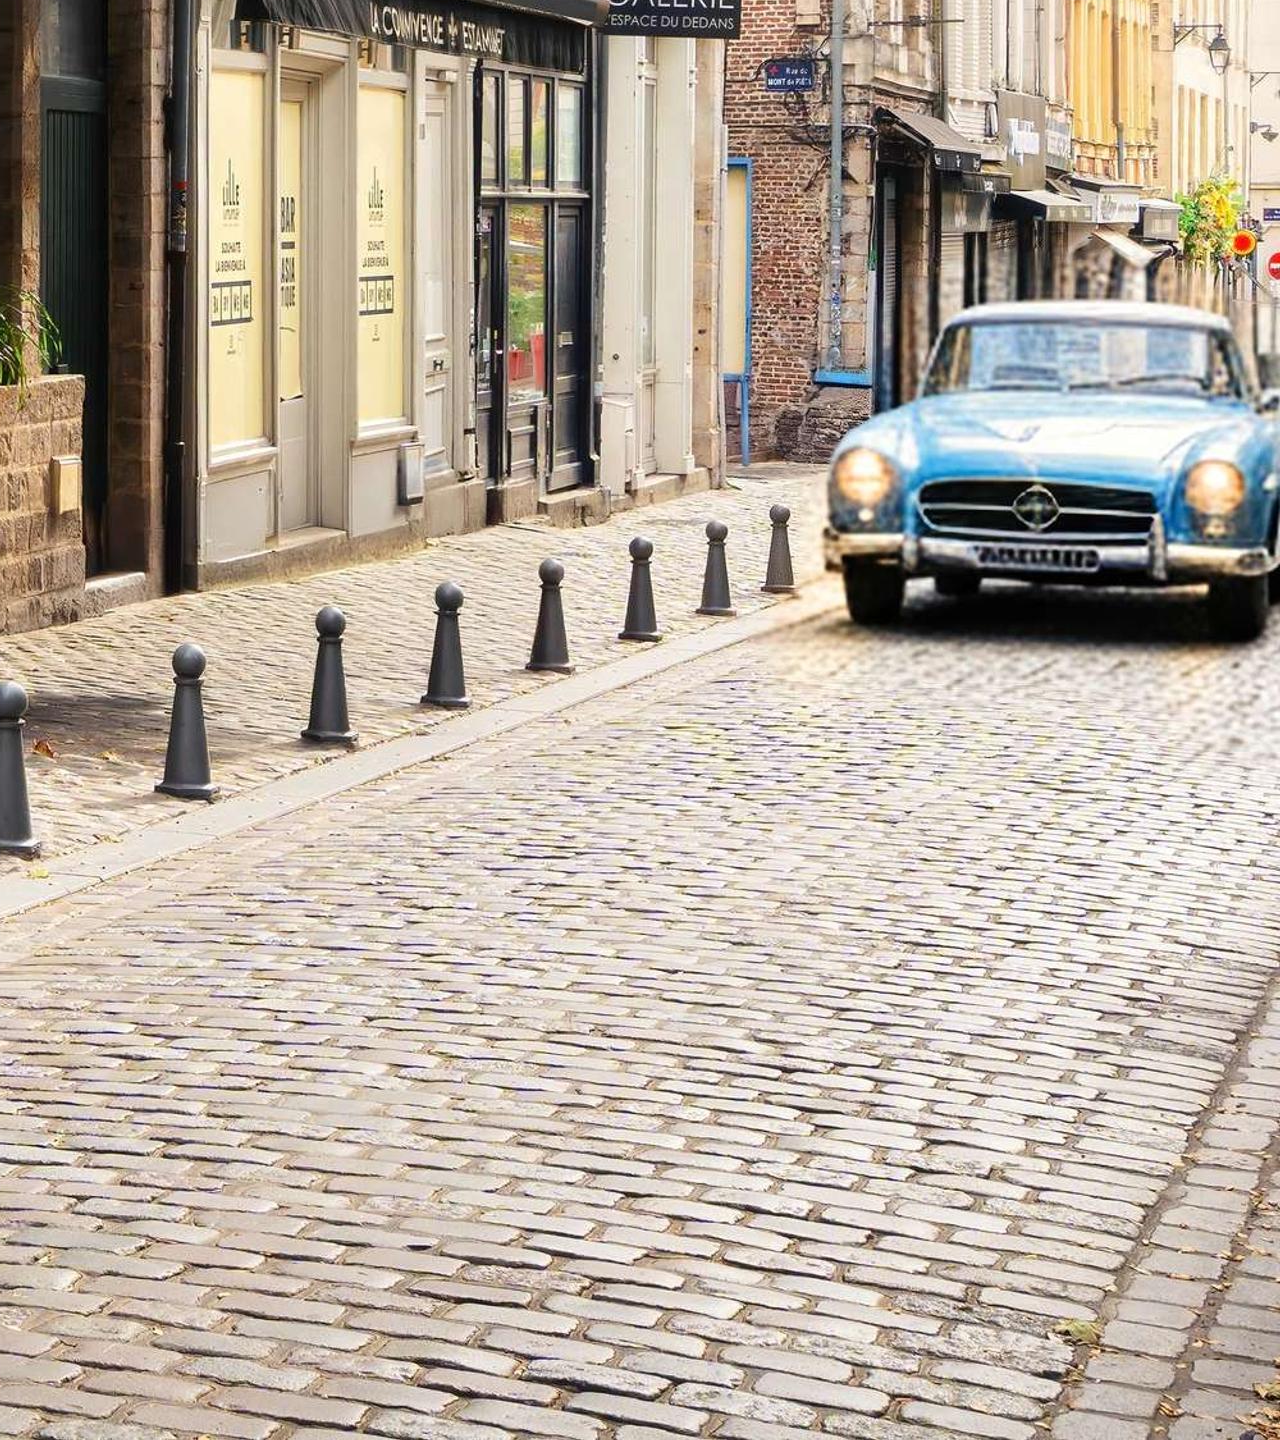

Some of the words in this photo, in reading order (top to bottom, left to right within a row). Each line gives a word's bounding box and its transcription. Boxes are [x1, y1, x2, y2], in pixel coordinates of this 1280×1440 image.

[369, 2, 381, 34] LA
[605, 14, 657, 27] 'ESPACE
[661, 16, 679, 27] DU
[682, 16, 735, 30] DEDANS
[280, 196, 295, 233] BAR
[281, 257, 295, 283] ASIA
